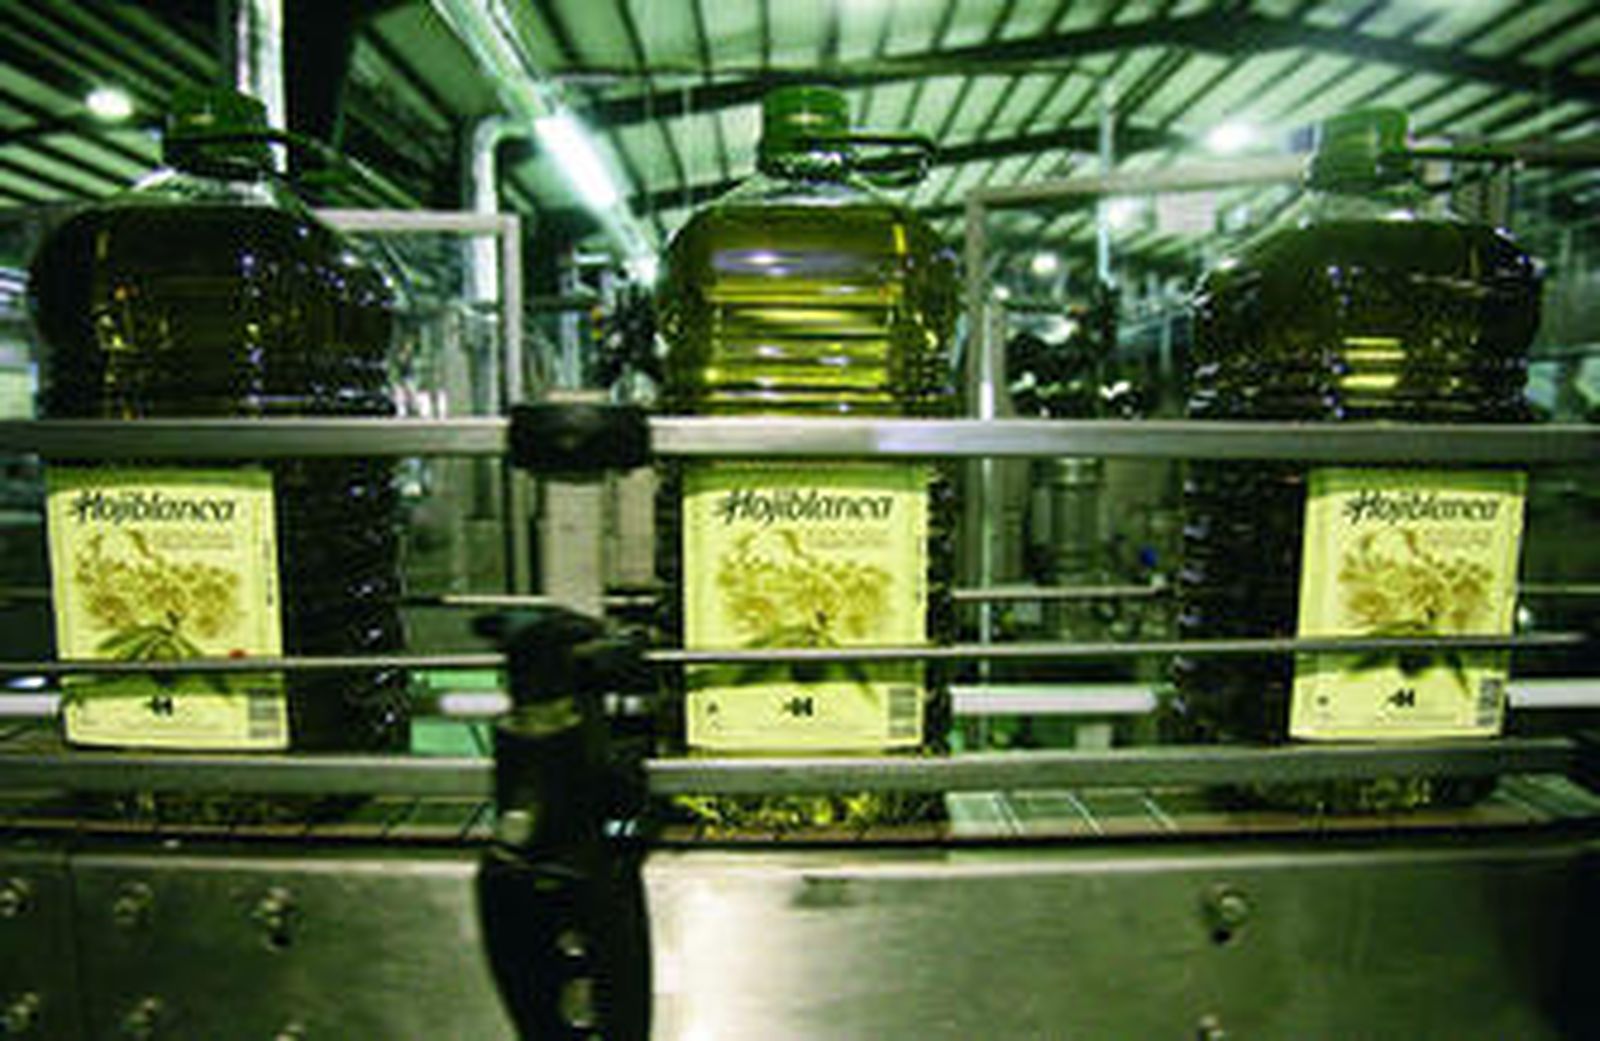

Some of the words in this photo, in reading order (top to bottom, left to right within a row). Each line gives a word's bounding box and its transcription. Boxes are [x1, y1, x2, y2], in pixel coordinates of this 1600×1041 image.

[72, 490, 236, 525] Hojiblanca
[716, 489, 894, 525] Hojiblanca
[1344, 489, 1499, 525] Hojiblanca
